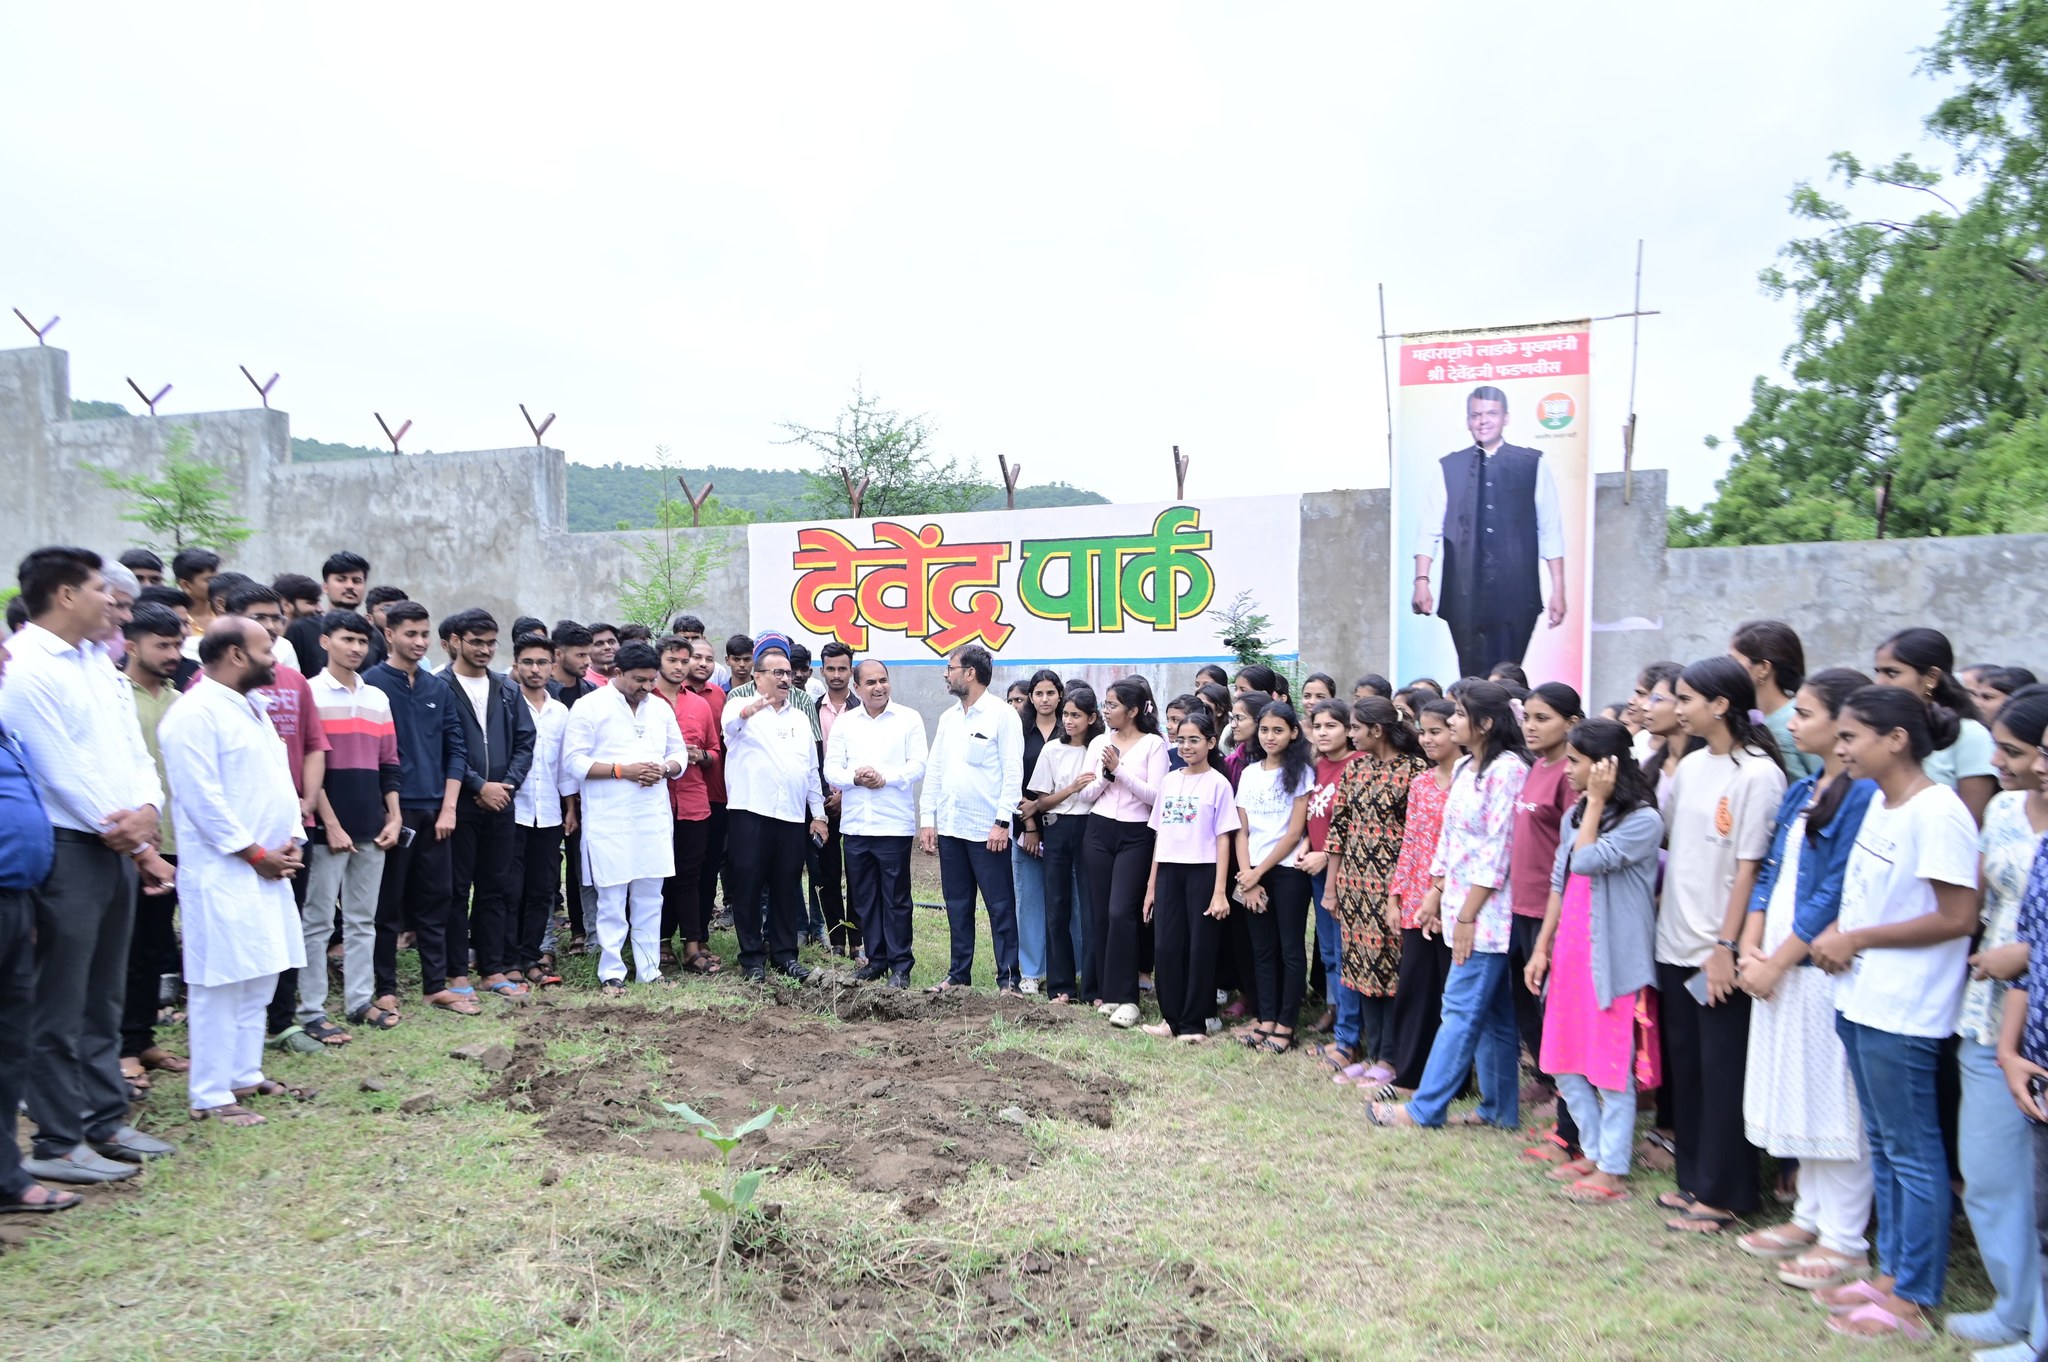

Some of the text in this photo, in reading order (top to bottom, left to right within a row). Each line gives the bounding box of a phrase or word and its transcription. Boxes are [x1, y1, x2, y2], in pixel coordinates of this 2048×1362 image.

[1475, 340, 1519, 357] लाडके
[1520, 335, 1578, 357] मुख्यमंत्री
[1427, 358, 1561, 381] श्री देवेंद्रजी फडणवीस
[791, 506, 1215, 657] देवेंद्र पार्क
